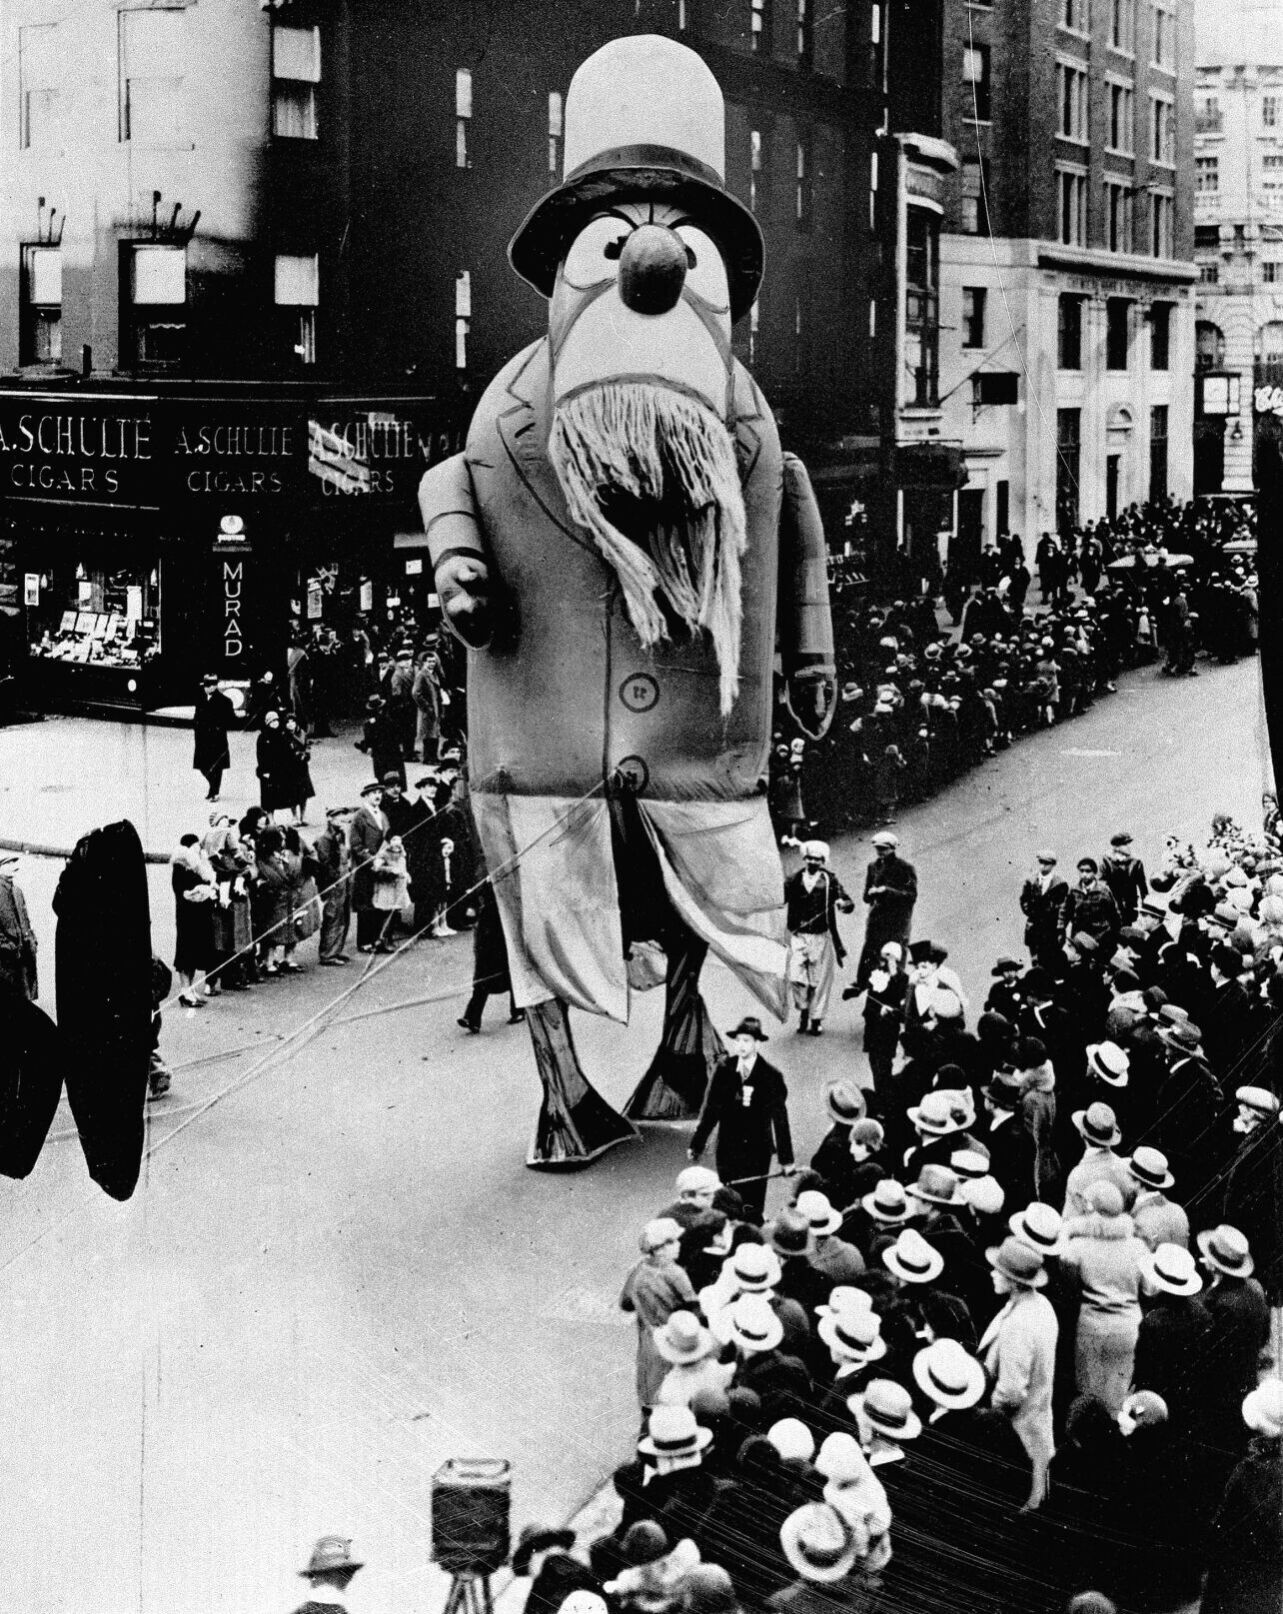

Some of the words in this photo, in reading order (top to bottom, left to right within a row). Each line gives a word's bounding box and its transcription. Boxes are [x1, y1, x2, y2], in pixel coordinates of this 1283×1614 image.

[11, 464, 119, 493] CIGARS
[187, 471, 282, 493] CIGARS
[223, 561, 243, 657] MURAD
